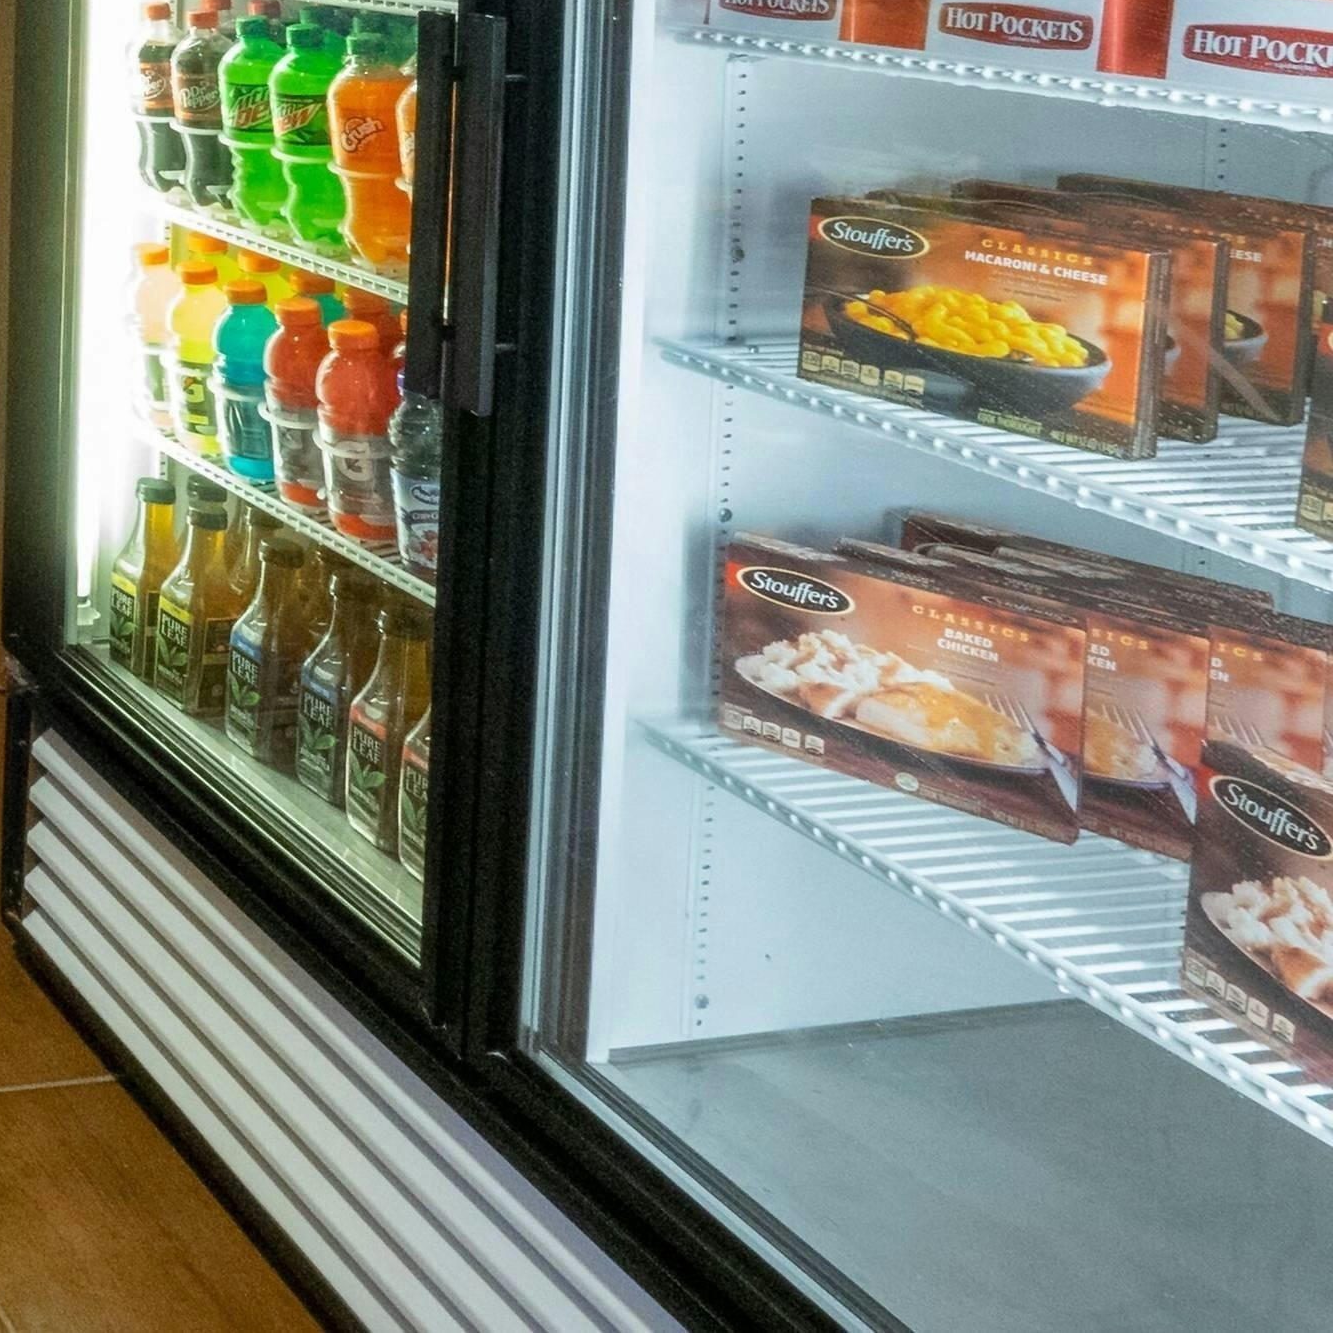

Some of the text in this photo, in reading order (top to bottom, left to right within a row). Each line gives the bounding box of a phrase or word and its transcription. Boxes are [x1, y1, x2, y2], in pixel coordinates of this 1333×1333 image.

[945, 6, 1084, 43] HOT POCKETS
[1192, 28, 1247, 57] HOT
[181, 88, 219, 109] Pepper
[830, 220, 915, 255] Stouffer's
[981, 238, 1094, 266] CLASSICS
[965, 250, 1109, 287] MACARONI & CHEESE
[112, 588, 134, 607] PURE
[750, 571, 840, 610] Stouffer's
[112, 595, 133, 618] LEAF
[161, 623, 189, 650] LEAF
[162, 613, 190, 635] PURE
[912, 604, 1030, 643] CLASSICS
[936, 638, 1000, 663] CHICKEN
[944, 627, 994, 649] BAKED
[232, 651, 259, 674] PURE
[232, 662, 258, 688] LEAF
[303, 702, 334, 729] LEAF
[304, 692, 333, 716] PURE
[352, 738, 381, 764] LEAF
[353, 727, 382, 751] PURE
[407, 766, 429, 790] PUR
[1224, 781, 1321, 852] Stouffer's
